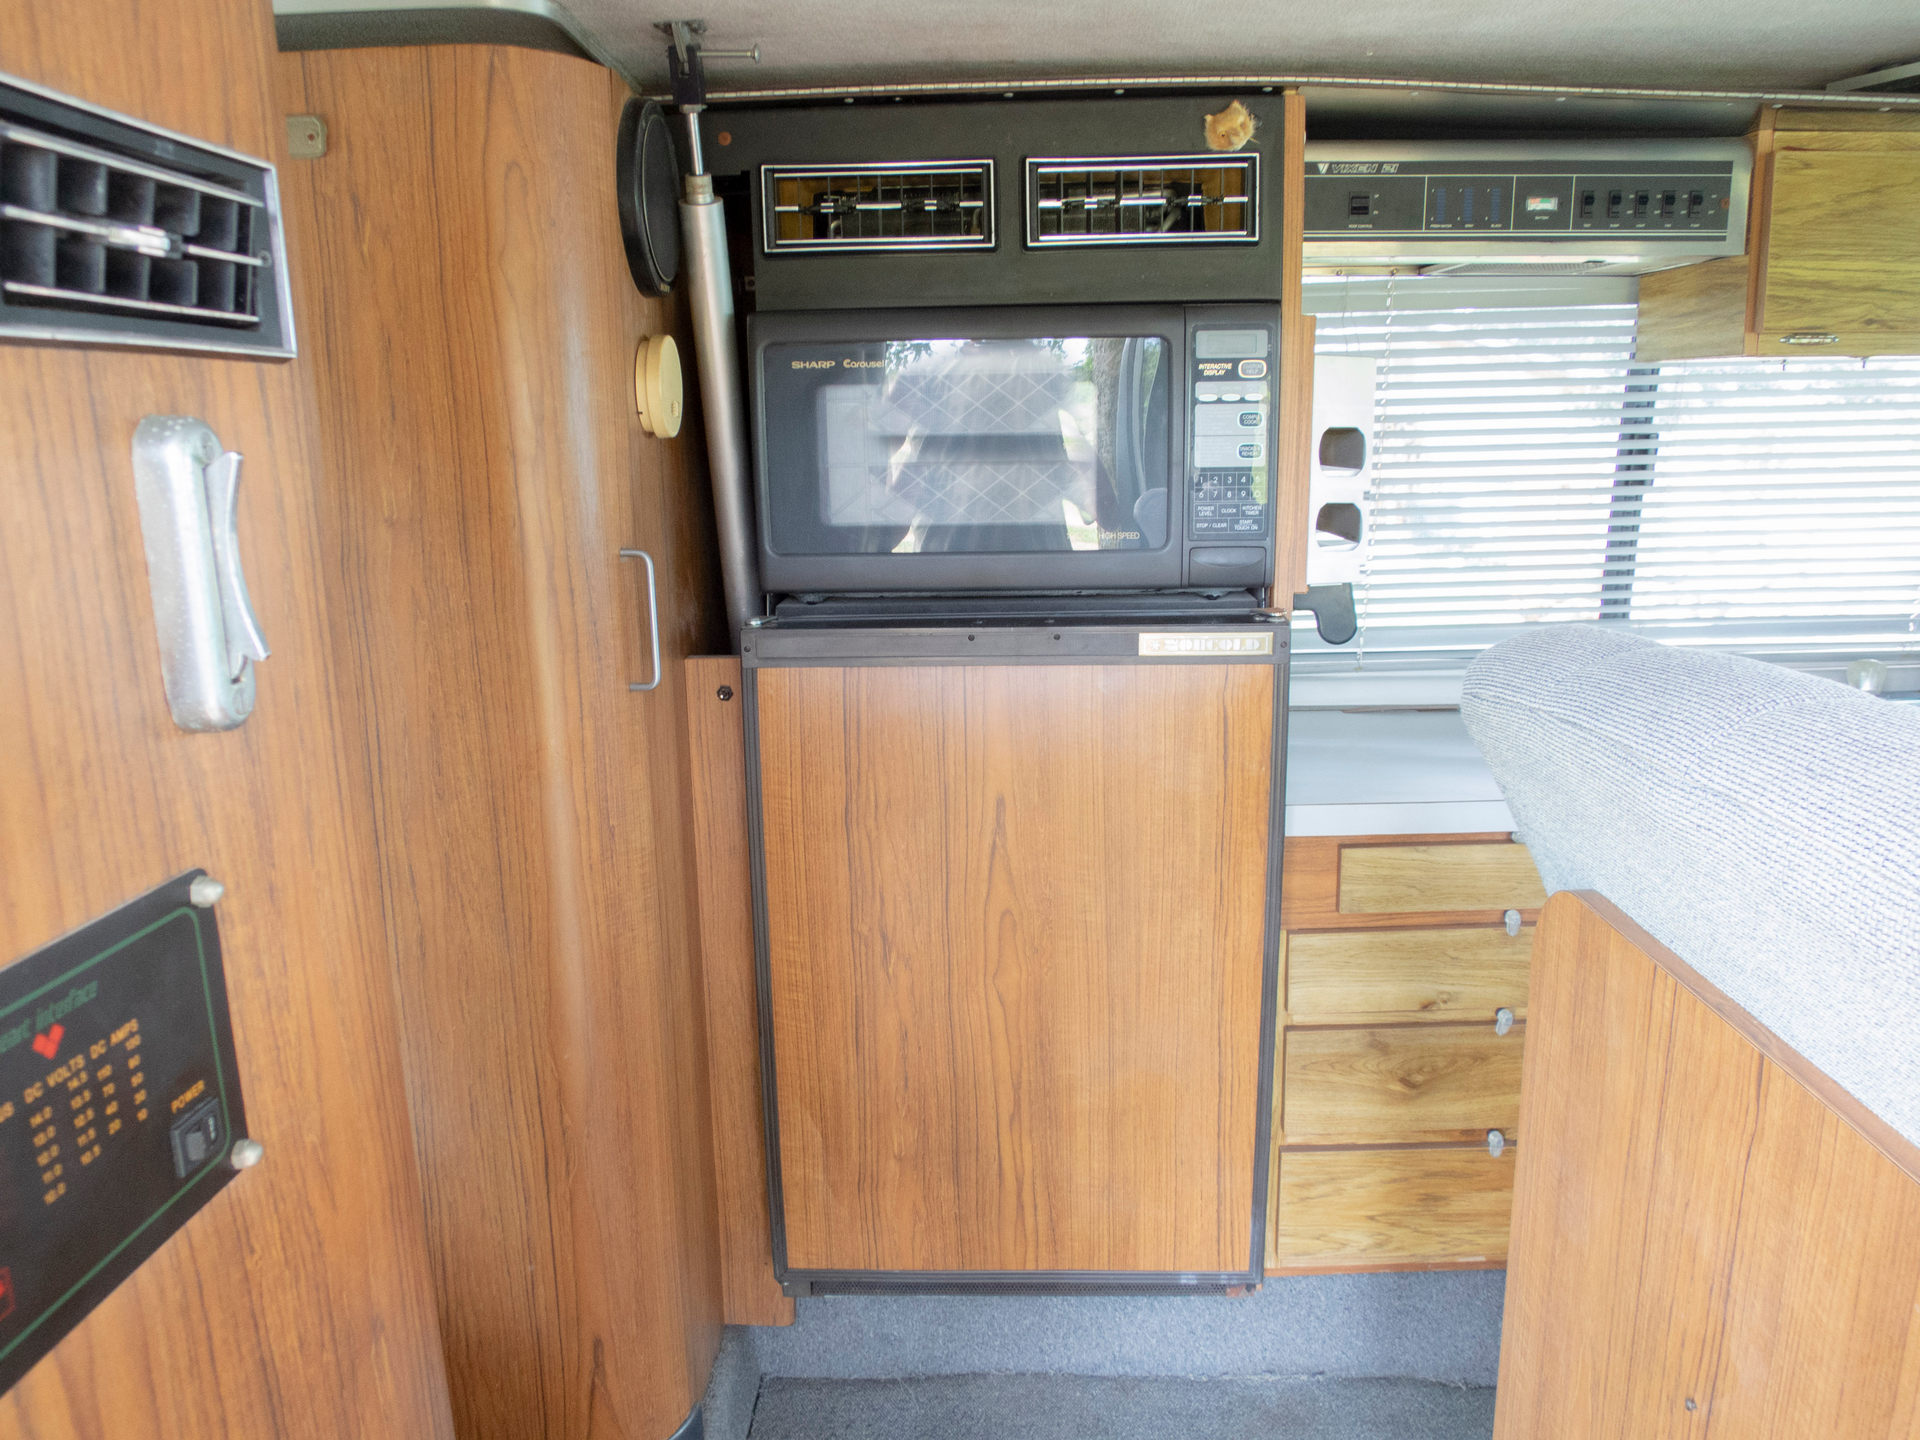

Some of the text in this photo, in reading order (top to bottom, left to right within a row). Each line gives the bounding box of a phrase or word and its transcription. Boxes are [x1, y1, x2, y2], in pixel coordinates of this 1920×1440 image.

[1331, 163, 1379, 174] VIXEN
[791, 358, 885, 370] SHARP Carousel
[1198, 362, 1233, 371] INTERACTIVE
[1203, 369, 1226, 377] DISPLAY
[1213, 476, 1219, 484] 2
[1226, 476, 1233, 484] 3
[1240, 475, 1247, 483] 4
[1198, 490, 1205, 498] 6
[1212, 490, 1218, 498] 7
[1226, 490, 1233, 498] 8
[1118, 531, 1140, 540] SPEED
[24, 1081, 43, 1104] DC
[46, 1054, 85, 1088] VOLTS
[89, 1039, 107, 1060] DC
[110, 1018, 139, 1046] AMPS
[170, 1079, 206, 1114] POWER
